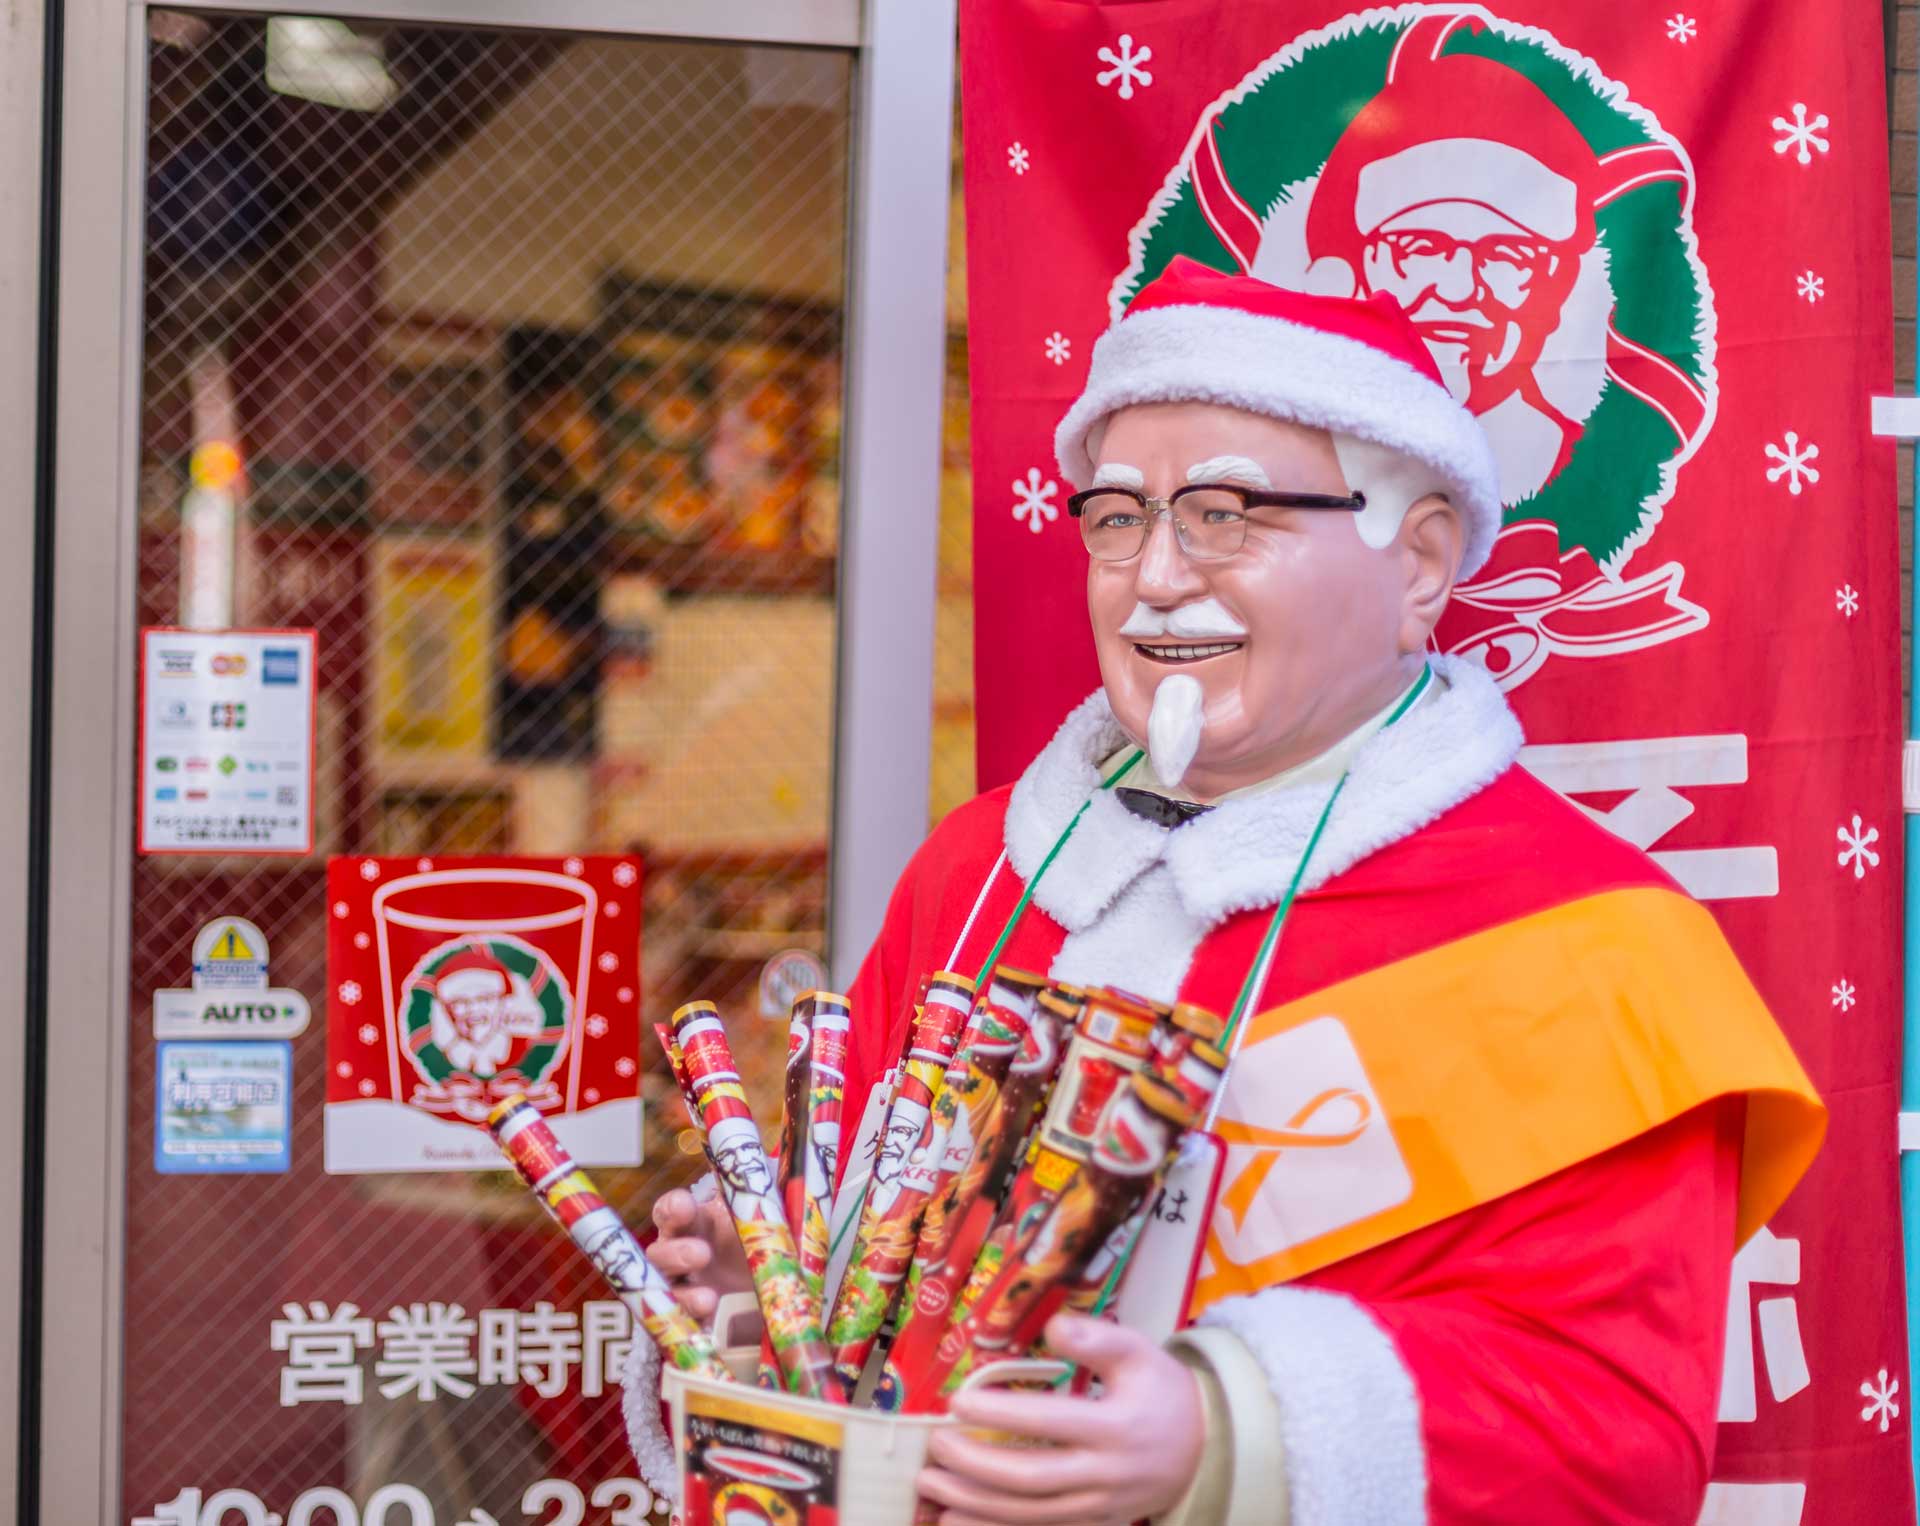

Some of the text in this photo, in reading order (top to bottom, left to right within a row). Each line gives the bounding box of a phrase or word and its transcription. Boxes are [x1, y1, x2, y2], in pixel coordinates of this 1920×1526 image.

[203, 1003, 277, 1022] AUTO
[900, 1166, 939, 1183] KFC
[269, 1300, 633, 1408] 営業時間
